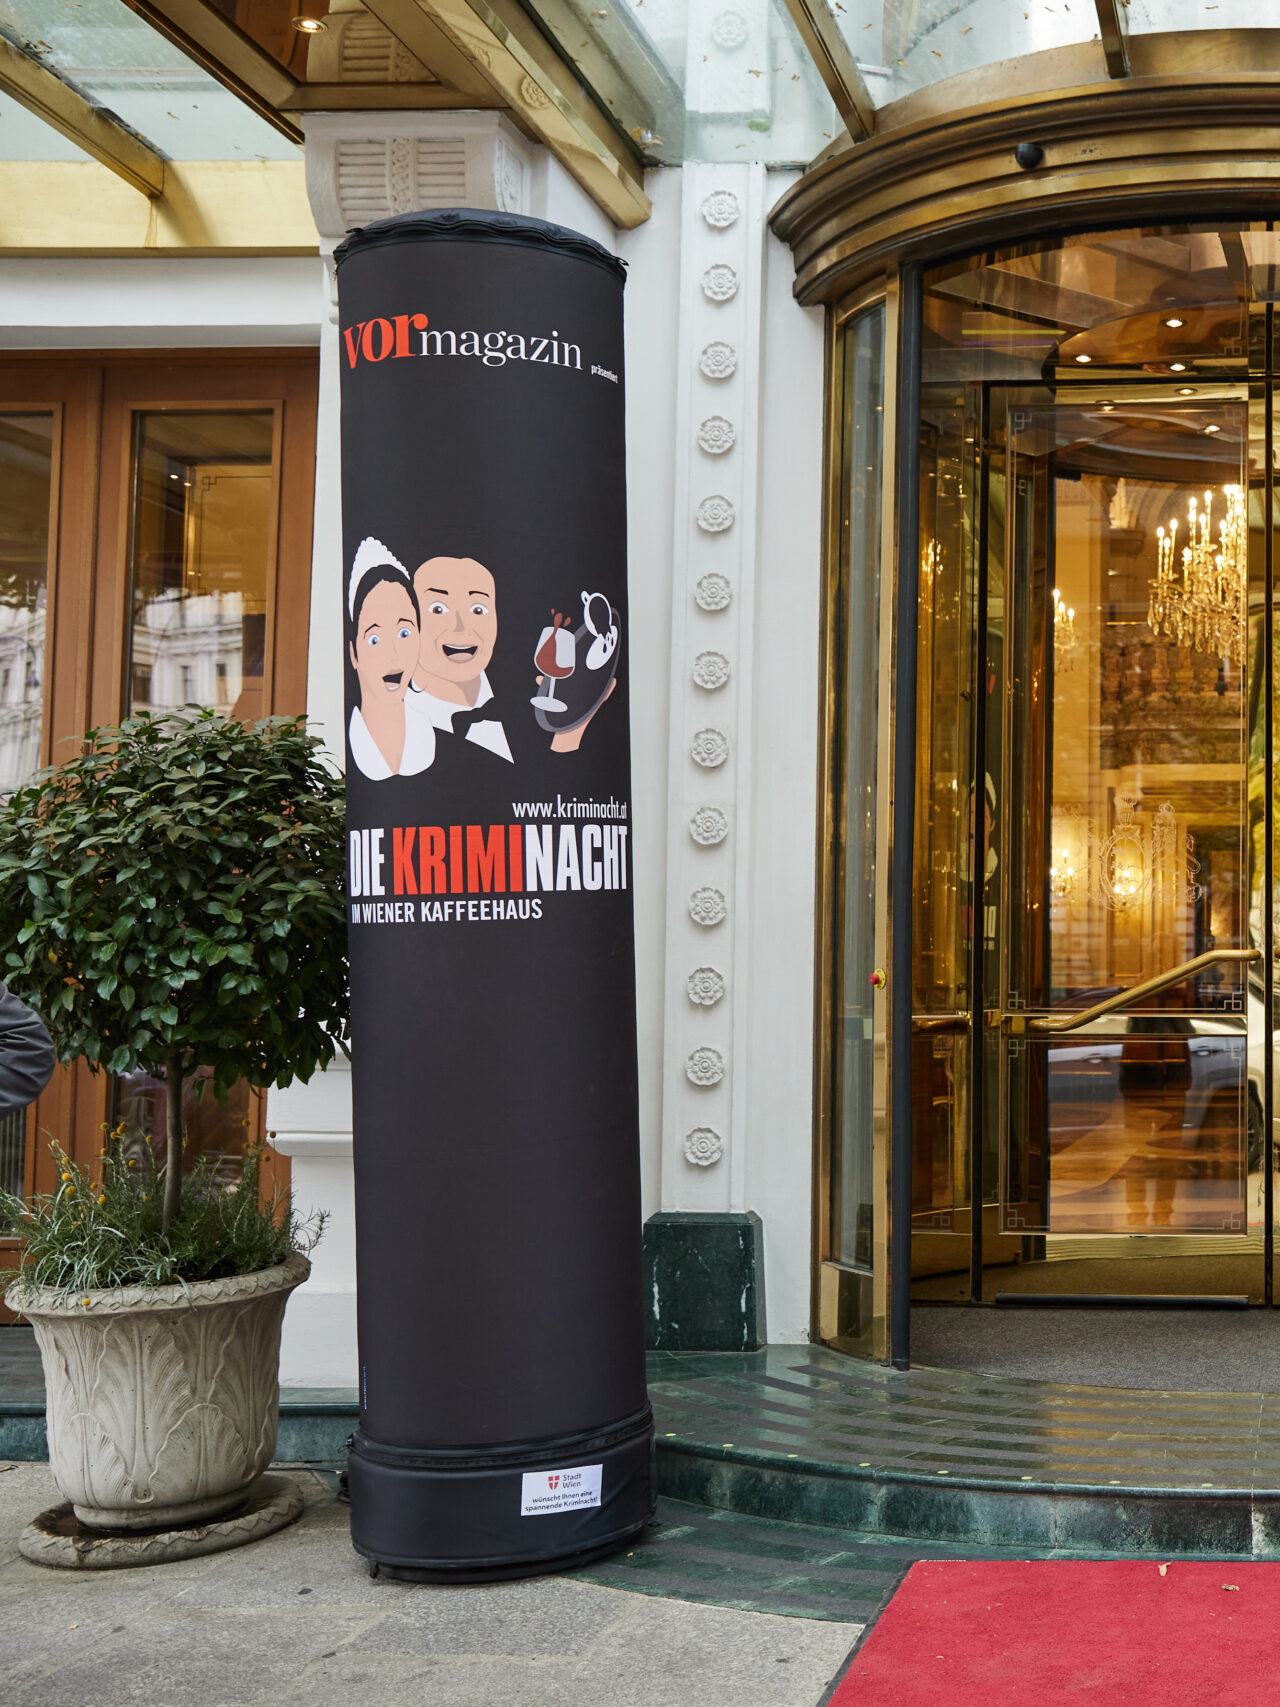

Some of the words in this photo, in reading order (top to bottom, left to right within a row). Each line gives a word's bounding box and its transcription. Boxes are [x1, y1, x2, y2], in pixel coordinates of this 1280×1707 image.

[512, 794, 627, 820] www.kriminacht.at
[350, 828, 385, 897] DIE
[351, 903, 361, 924] IM
[362, 902, 415, 924] WIENER
[421, 898, 543, 922] KAFFEEHAUS
[562, 1473, 582, 1482] Stadt
[562, 1481, 581, 1489] Wien
[525, 1502, 562, 1512] spannende
[563, 1496, 598, 1507] Kriminacht!
[532, 1495, 560, 1503] wünscht
[562, 1492, 580, 1500] Ihnen
